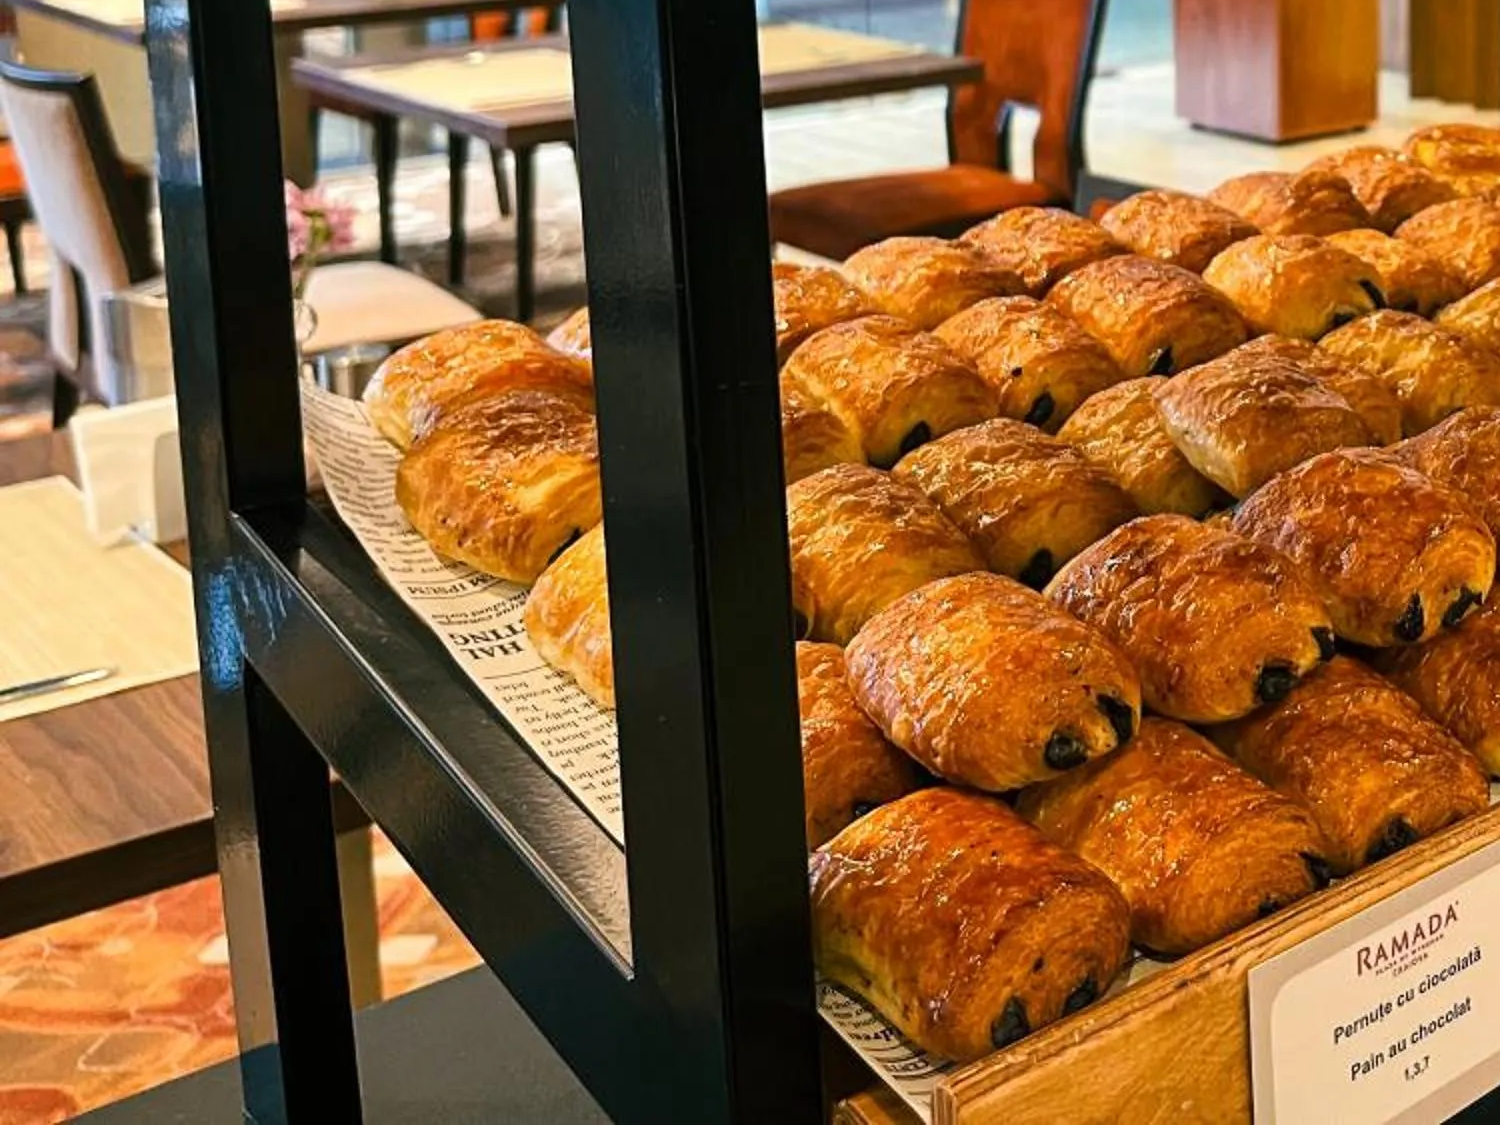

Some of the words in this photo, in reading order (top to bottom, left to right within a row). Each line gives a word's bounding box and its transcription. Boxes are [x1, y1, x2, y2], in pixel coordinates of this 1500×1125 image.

[407, 578, 466, 598] IPSUM
[448, 619, 526, 648] TING
[1357, 904, 1459, 977] RAMADA
[1397, 989, 1416, 1008] cu
[1418, 946, 1482, 995] ciocolată
[1350, 1052, 1385, 1082] Pain
[1389, 1039, 1408, 1059] au
[1410, 997, 1472, 1045] chocolat
